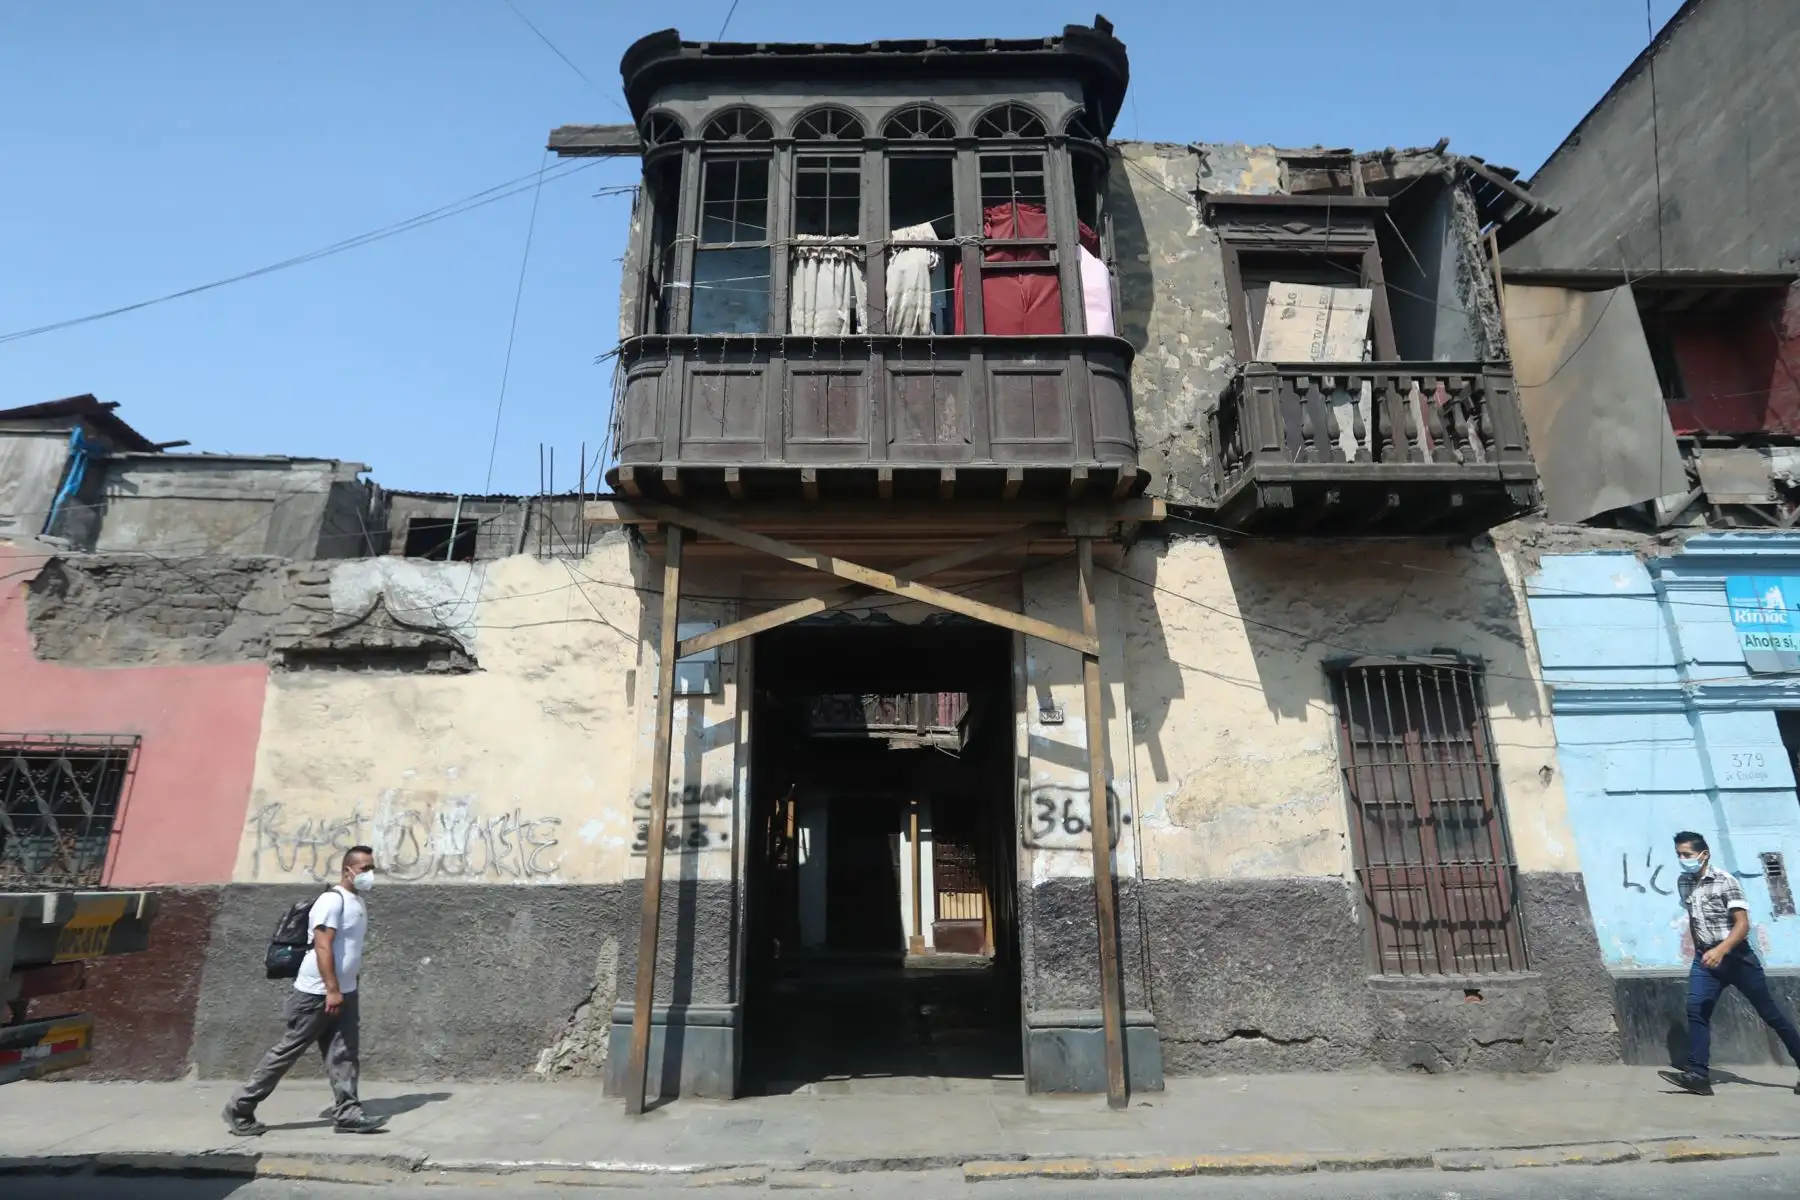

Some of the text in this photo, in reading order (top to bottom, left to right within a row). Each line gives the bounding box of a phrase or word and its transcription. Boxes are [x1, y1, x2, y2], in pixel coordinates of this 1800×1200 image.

[1287, 292, 1298, 307] LG
[1316, 311, 1327, 322] TV
[1313, 328, 1323, 341] TV
[1745, 633, 1781, 648] Ahora
[1731, 752, 1765, 768] 379
[1033, 793, 1094, 839] 36
